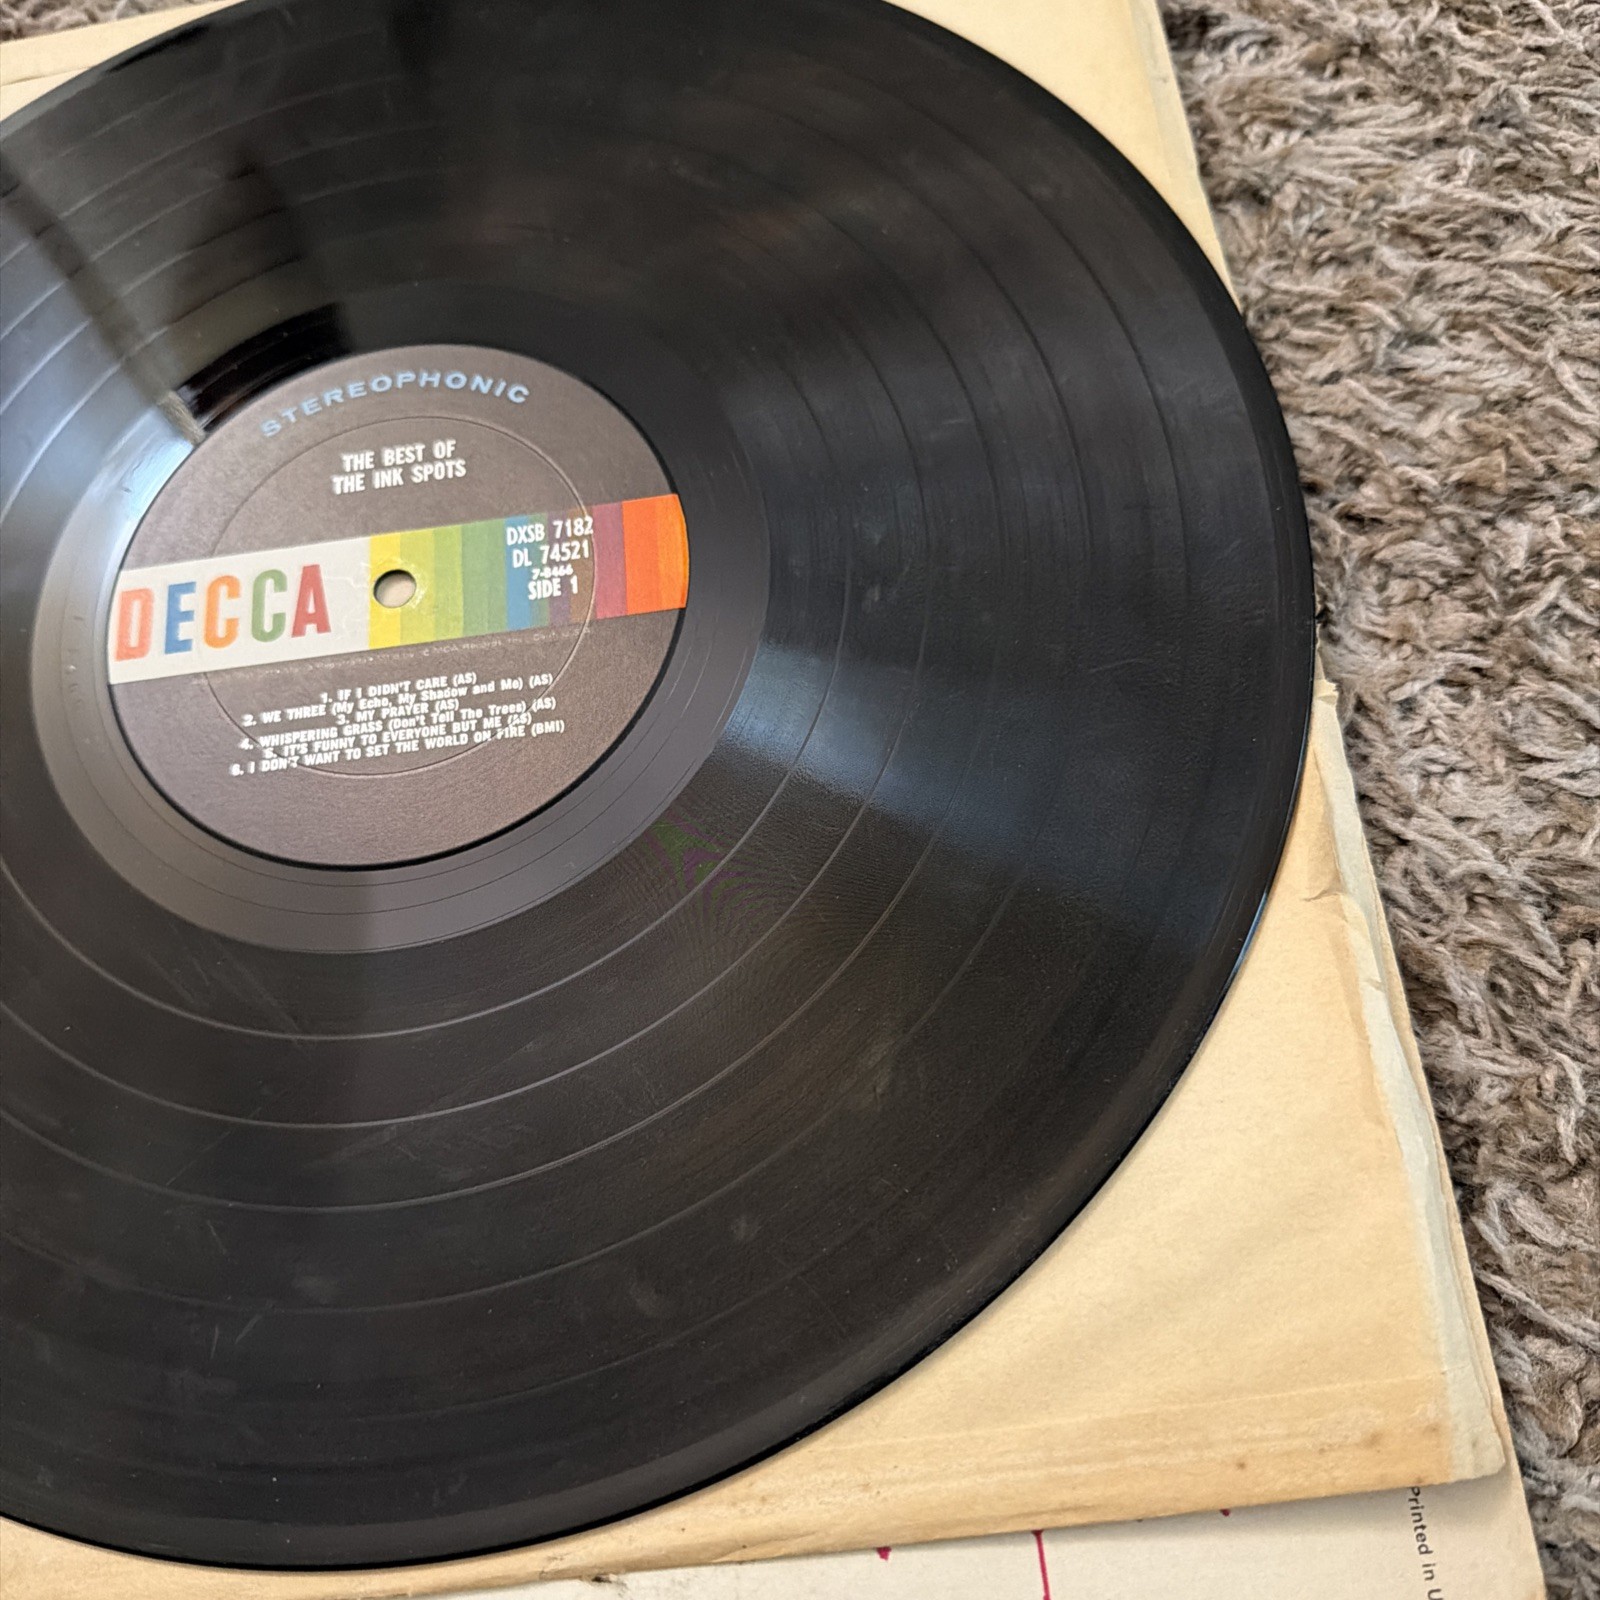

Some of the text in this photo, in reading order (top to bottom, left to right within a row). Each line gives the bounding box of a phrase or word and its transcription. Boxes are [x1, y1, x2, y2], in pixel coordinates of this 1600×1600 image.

[260, 371, 530, 437] STEREOPHONIC
[341, 439, 457, 472] THE BEST OF
[330, 459, 467, 495] THE INK SPOTS
[506, 515, 594, 546] DXSB 7182
[512, 539, 590, 569] DL 74521
[527, 574, 579, 601] SIDE 1
[115, 564, 332, 662] DECCA
[242, 673, 554, 727] 2. WE THREE (My Echo, My Shadow and Me) (AS)
[320, 672, 477, 704] 1. IF I DIDN'T CARE (AS)
[239, 696, 557, 750] 4. WHISPERING GRASS (Don't Tell The Trees) (AS)
[336, 698, 460, 726] 3. MY PRAYER (AS)
[230, 720, 565, 776] 6. I DON'T WANT TO SET THE WORLD ON FIRE (BMI)
[263, 712, 533, 759] 5. IT'S FUNNY TO EVERYONE BUT ME (AS)
[1408, 1486, 1434, 1555] Printed
[1422, 1563, 1436, 1581] in
